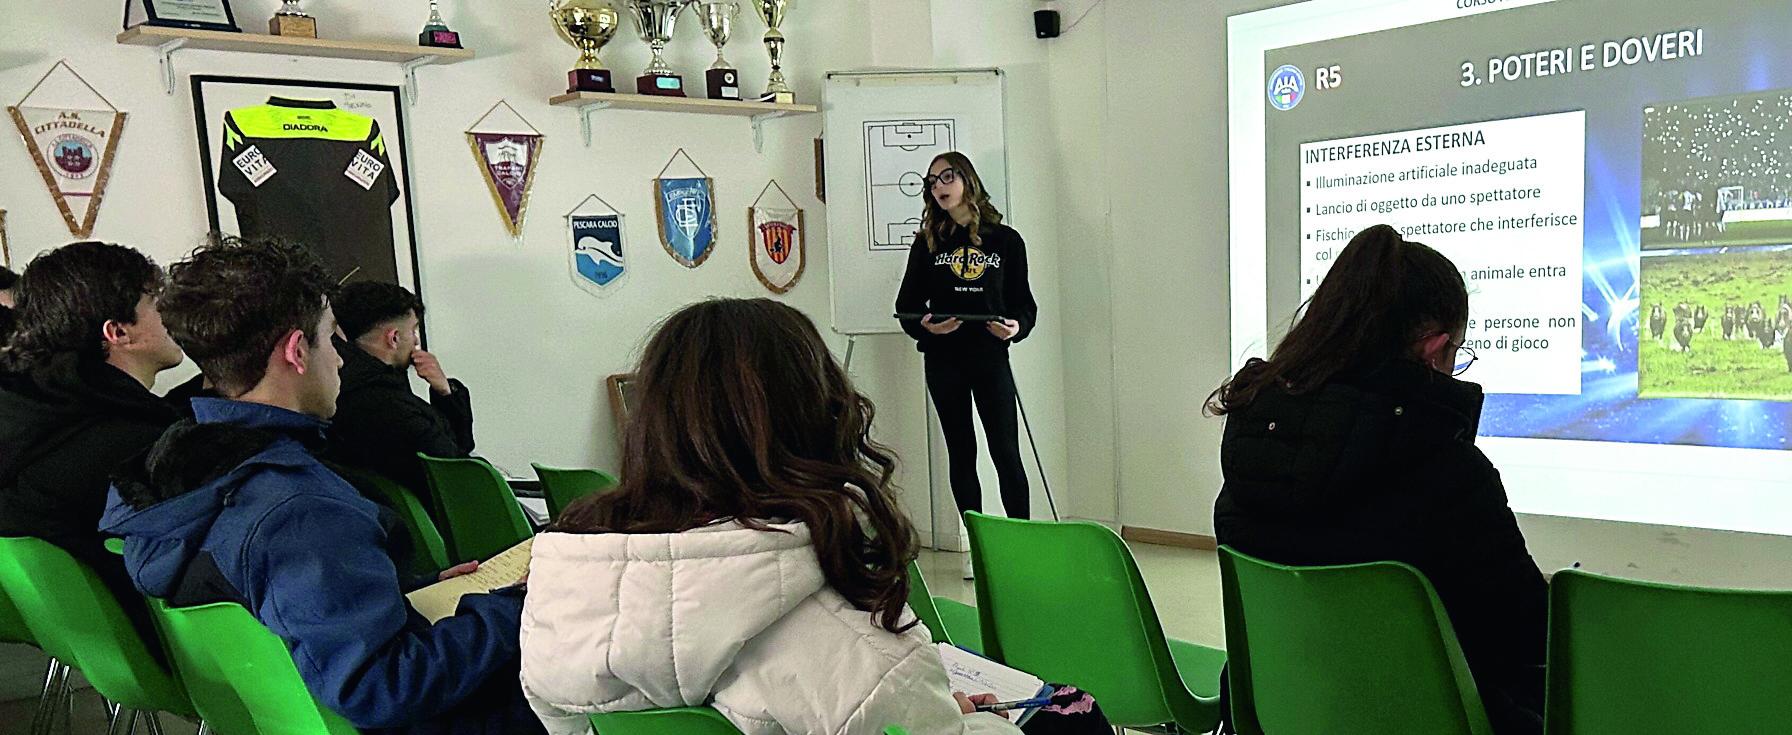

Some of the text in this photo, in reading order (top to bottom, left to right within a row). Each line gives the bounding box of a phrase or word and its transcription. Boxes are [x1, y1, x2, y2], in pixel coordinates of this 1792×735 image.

[1460, 28, 1704, 87] 3. POTERI E DOVERI
[1315, 65, 1342, 90] R5
[35, 121, 105, 138] CITTADELLA
[283, 123, 329, 133] DIADORA
[1304, 128, 1485, 164] INTERFERENZA ESTERNA
[1317, 157, 1537, 190] Illuminazione artificiale inadeguata
[1317, 187, 1541, 215] Lancio di oggetto da uno spettatore
[573, 220, 617, 229] PESCARA CALCIO
[1400, 221, 1466, 239] spettatore
[1470, 217, 1494, 231] che
[1499, 212, 1578, 230] interferisce
[969, 252, 1001, 268] Rock
[1316, 247, 1331, 260] col
[1470, 265, 1525, 280] animale
[1529, 265, 1566, 278] entra
[1485, 317, 1540, 331] persone
[1548, 317, 1576, 328] non
[1495, 335, 1508, 349] di
[1511, 335, 1549, 353] gioco
